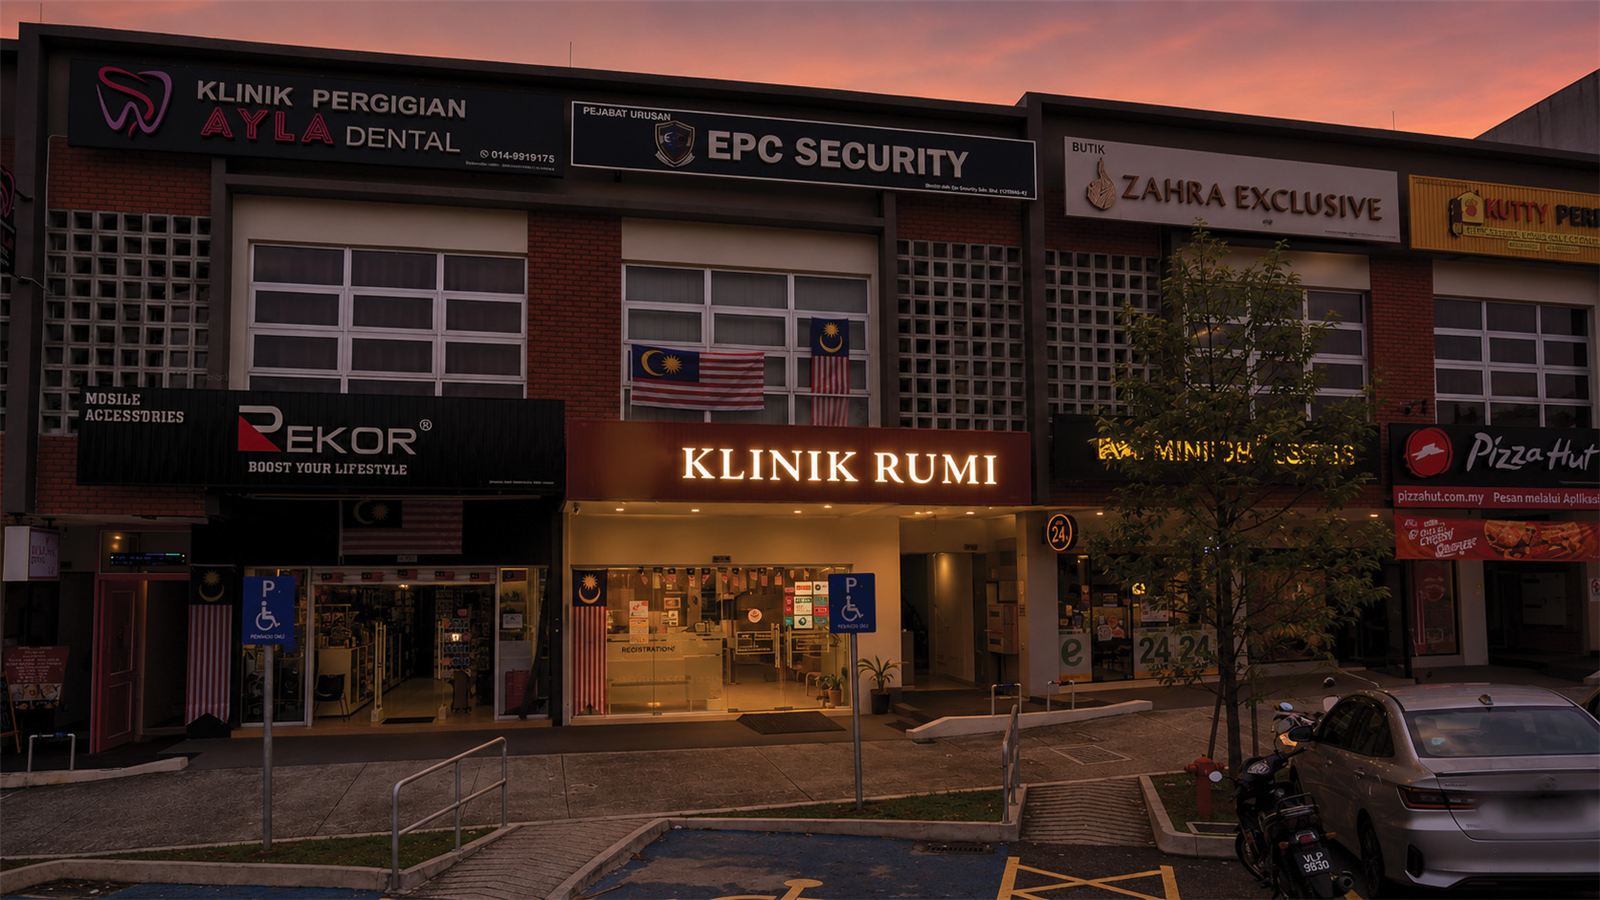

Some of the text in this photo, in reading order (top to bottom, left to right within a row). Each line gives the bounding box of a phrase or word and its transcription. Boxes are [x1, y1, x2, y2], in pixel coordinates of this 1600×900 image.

[197, 79, 466, 118] KLINIK PERGIGIAN
[583, 106, 671, 121] PEJABAT URUSAN
[200, 105, 461, 153] AYLA DENTAL
[707, 129, 969, 179] EPC SECURITY
[1072, 141, 1106, 155] BUTIK
[1121, 174, 1383, 222] ZAHRA EXCLUSIVE
[1486, 198, 1548, 225] KUTTY
[681, 446, 998, 486] KLINIK RUMI
[1466, 431, 1600, 473] Pizza Hut
[248, 461, 408, 476] BOOST YOUR LIFESTYLE
[1398, 490, 1484, 506] pizzahut.com.my
[1493, 492, 1523, 503] Pesan
[1525, 493, 1561, 504] melalui
[1139, 637, 1171, 665] 24
